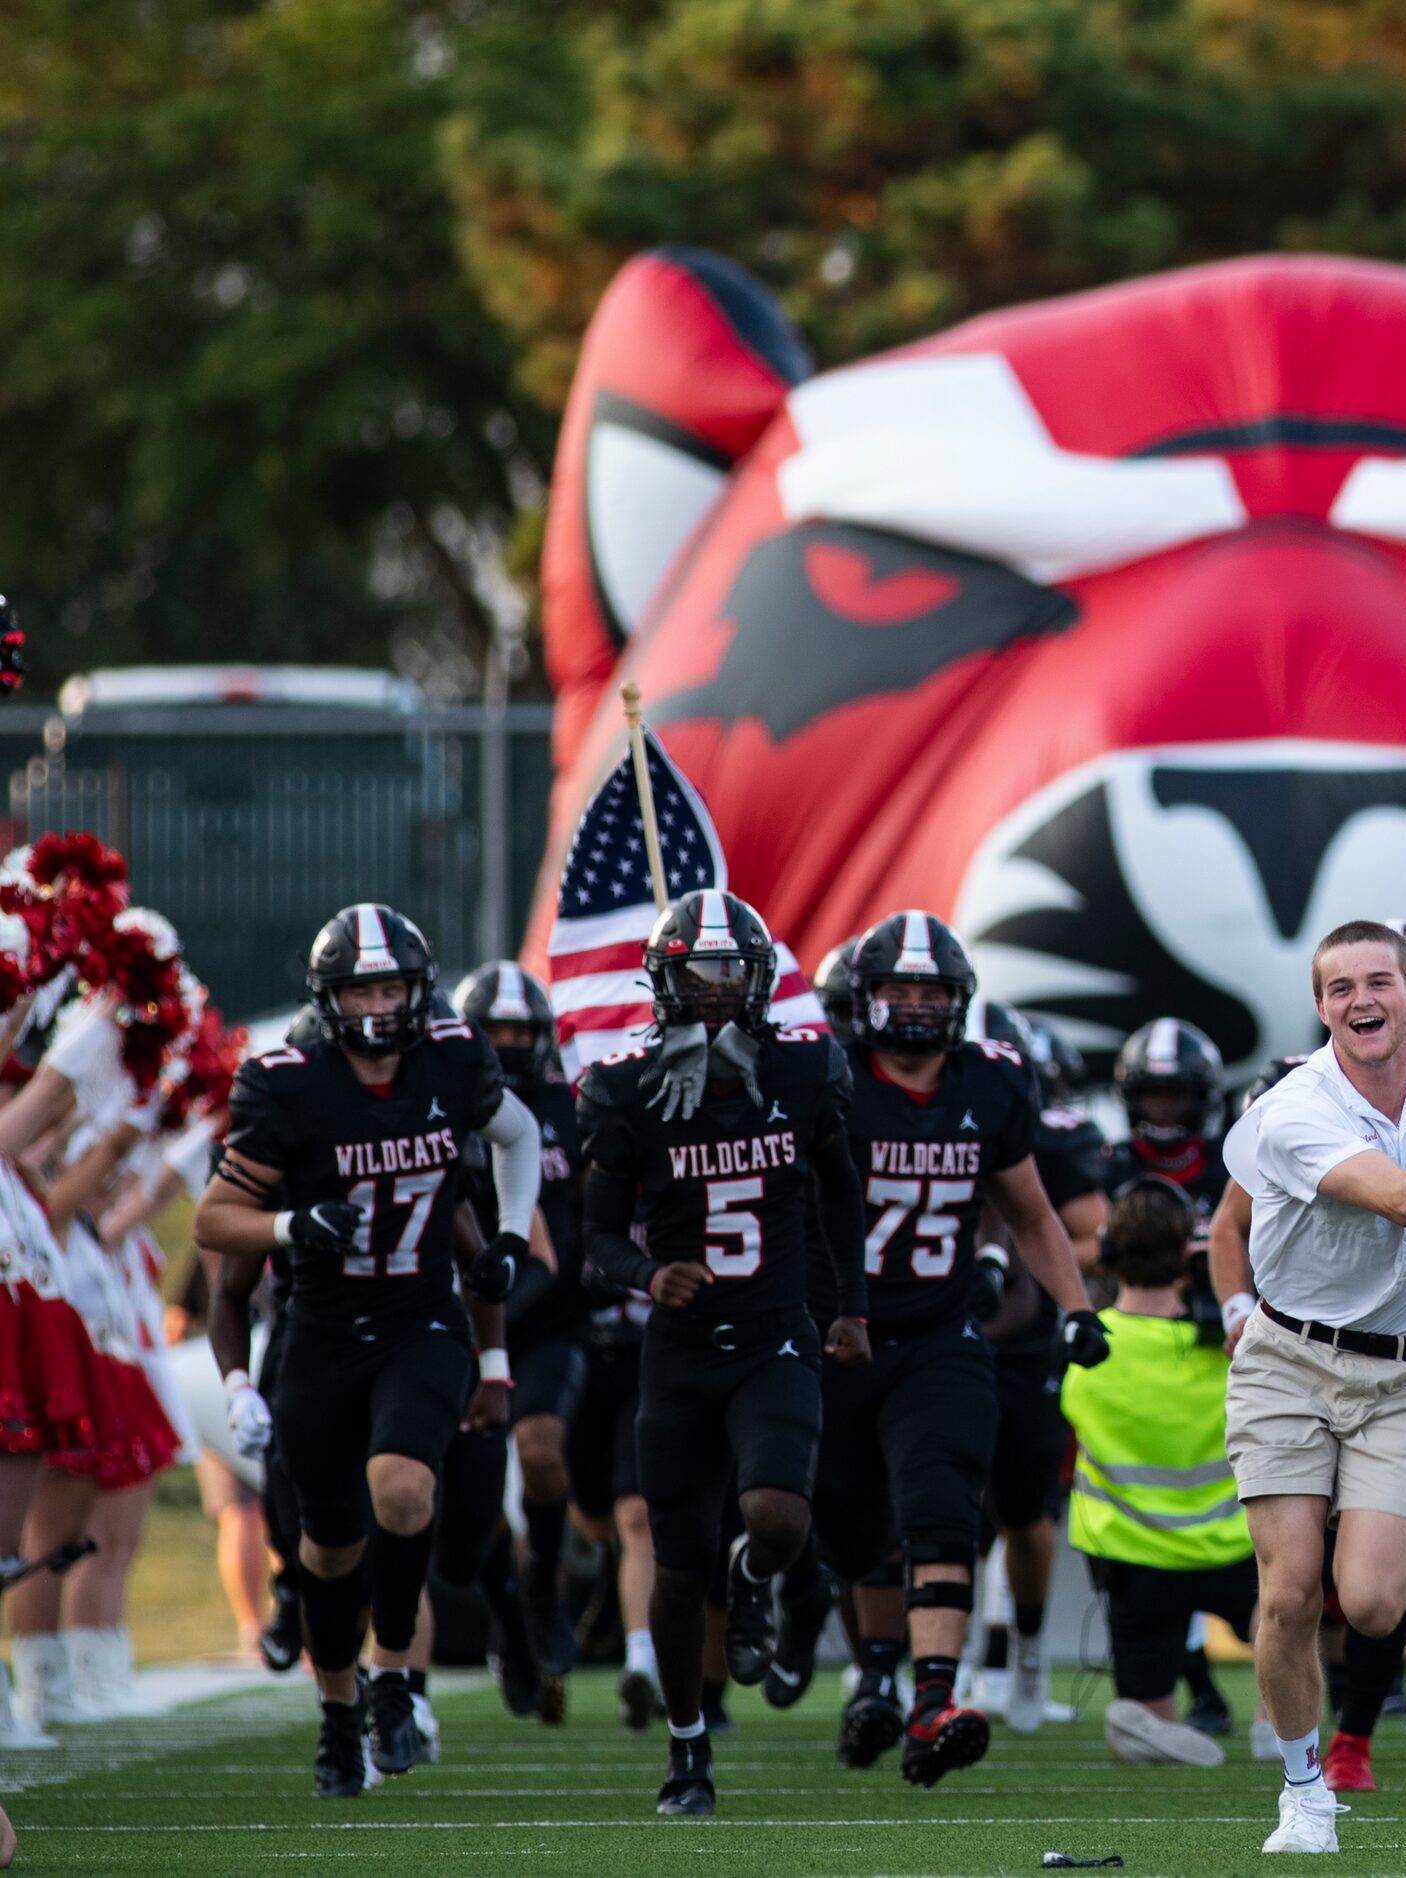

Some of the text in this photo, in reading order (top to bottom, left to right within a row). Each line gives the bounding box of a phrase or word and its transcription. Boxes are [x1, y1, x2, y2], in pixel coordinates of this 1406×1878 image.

[335, 1128, 459, 1178] WILDCATS
[669, 1132, 796, 1181] WILDCATS
[871, 1141, 981, 1175] WILDCATS
[343, 1168, 447, 1278] 17
[704, 1176, 763, 1279] 5
[864, 1177, 976, 1279] 75
